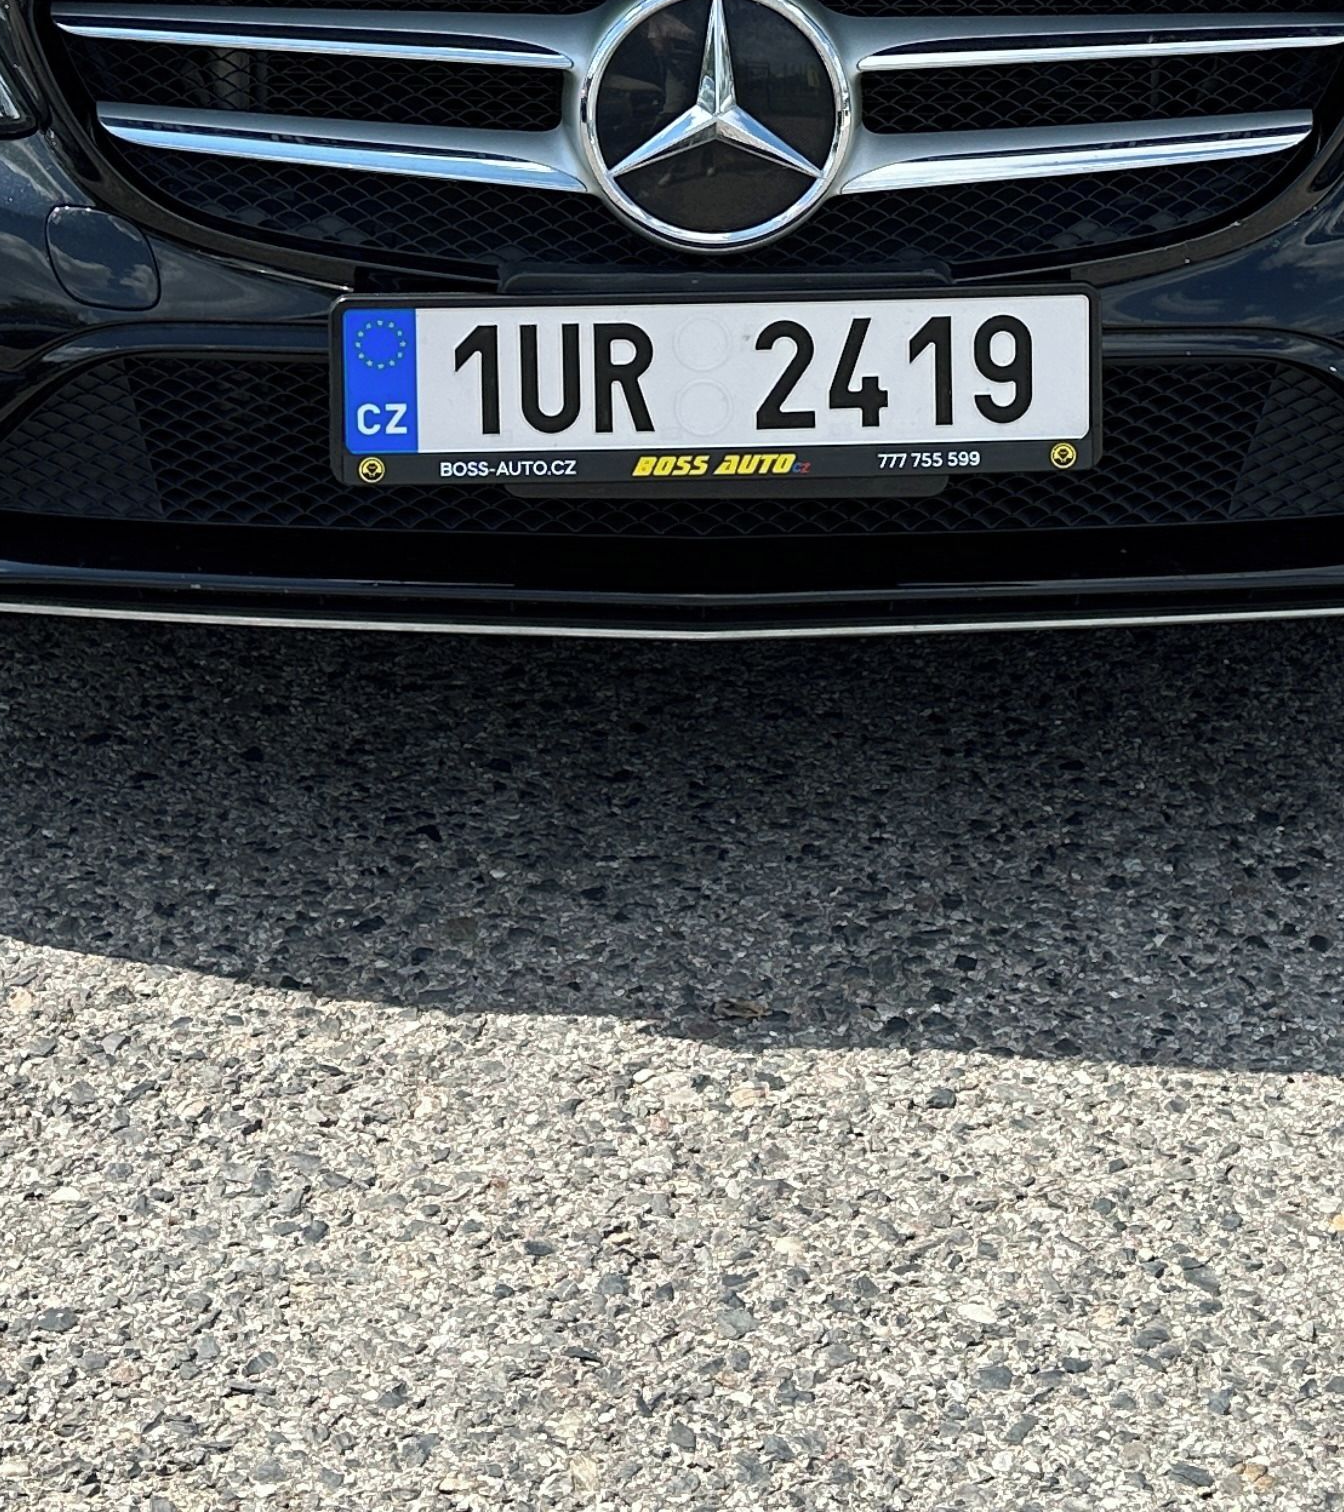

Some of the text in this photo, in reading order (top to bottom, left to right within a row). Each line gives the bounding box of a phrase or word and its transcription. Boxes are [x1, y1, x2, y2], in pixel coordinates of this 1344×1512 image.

[455, 315, 1034, 436] 1UR 2419
[355, 402, 408, 437] CZ
[439, 458, 577, 477] BOSS-AUTO.CZ
[631, 456, 710, 476] BOSS
[713, 453, 797, 474] AUTO
[878, 451, 906, 469] 777
[910, 451, 943, 468] 755
[946, 449, 981, 468] 599
